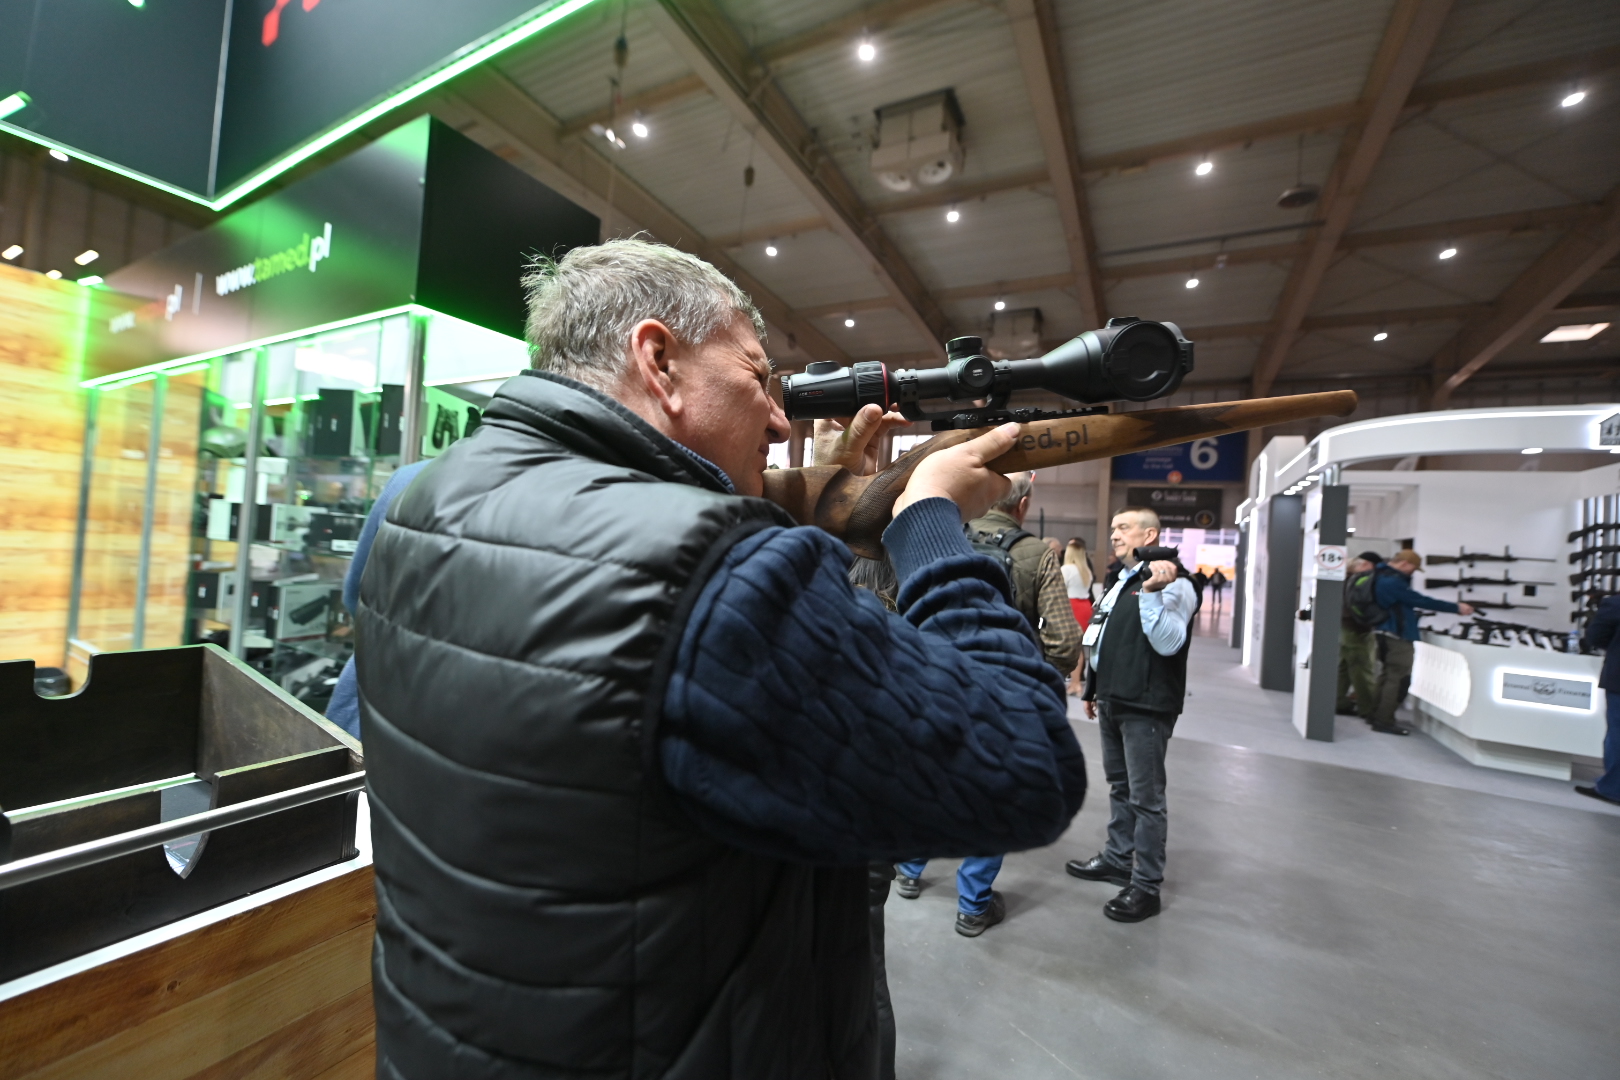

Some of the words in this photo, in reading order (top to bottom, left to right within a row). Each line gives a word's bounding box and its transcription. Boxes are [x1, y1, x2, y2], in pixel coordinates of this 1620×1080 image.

[216, 222, 332, 296] www.tamed.pl
[1014, 423, 1089, 451] ed.pl
[1190, 437, 1218, 470] 6
[1320, 553, 1343, 562] 18+
